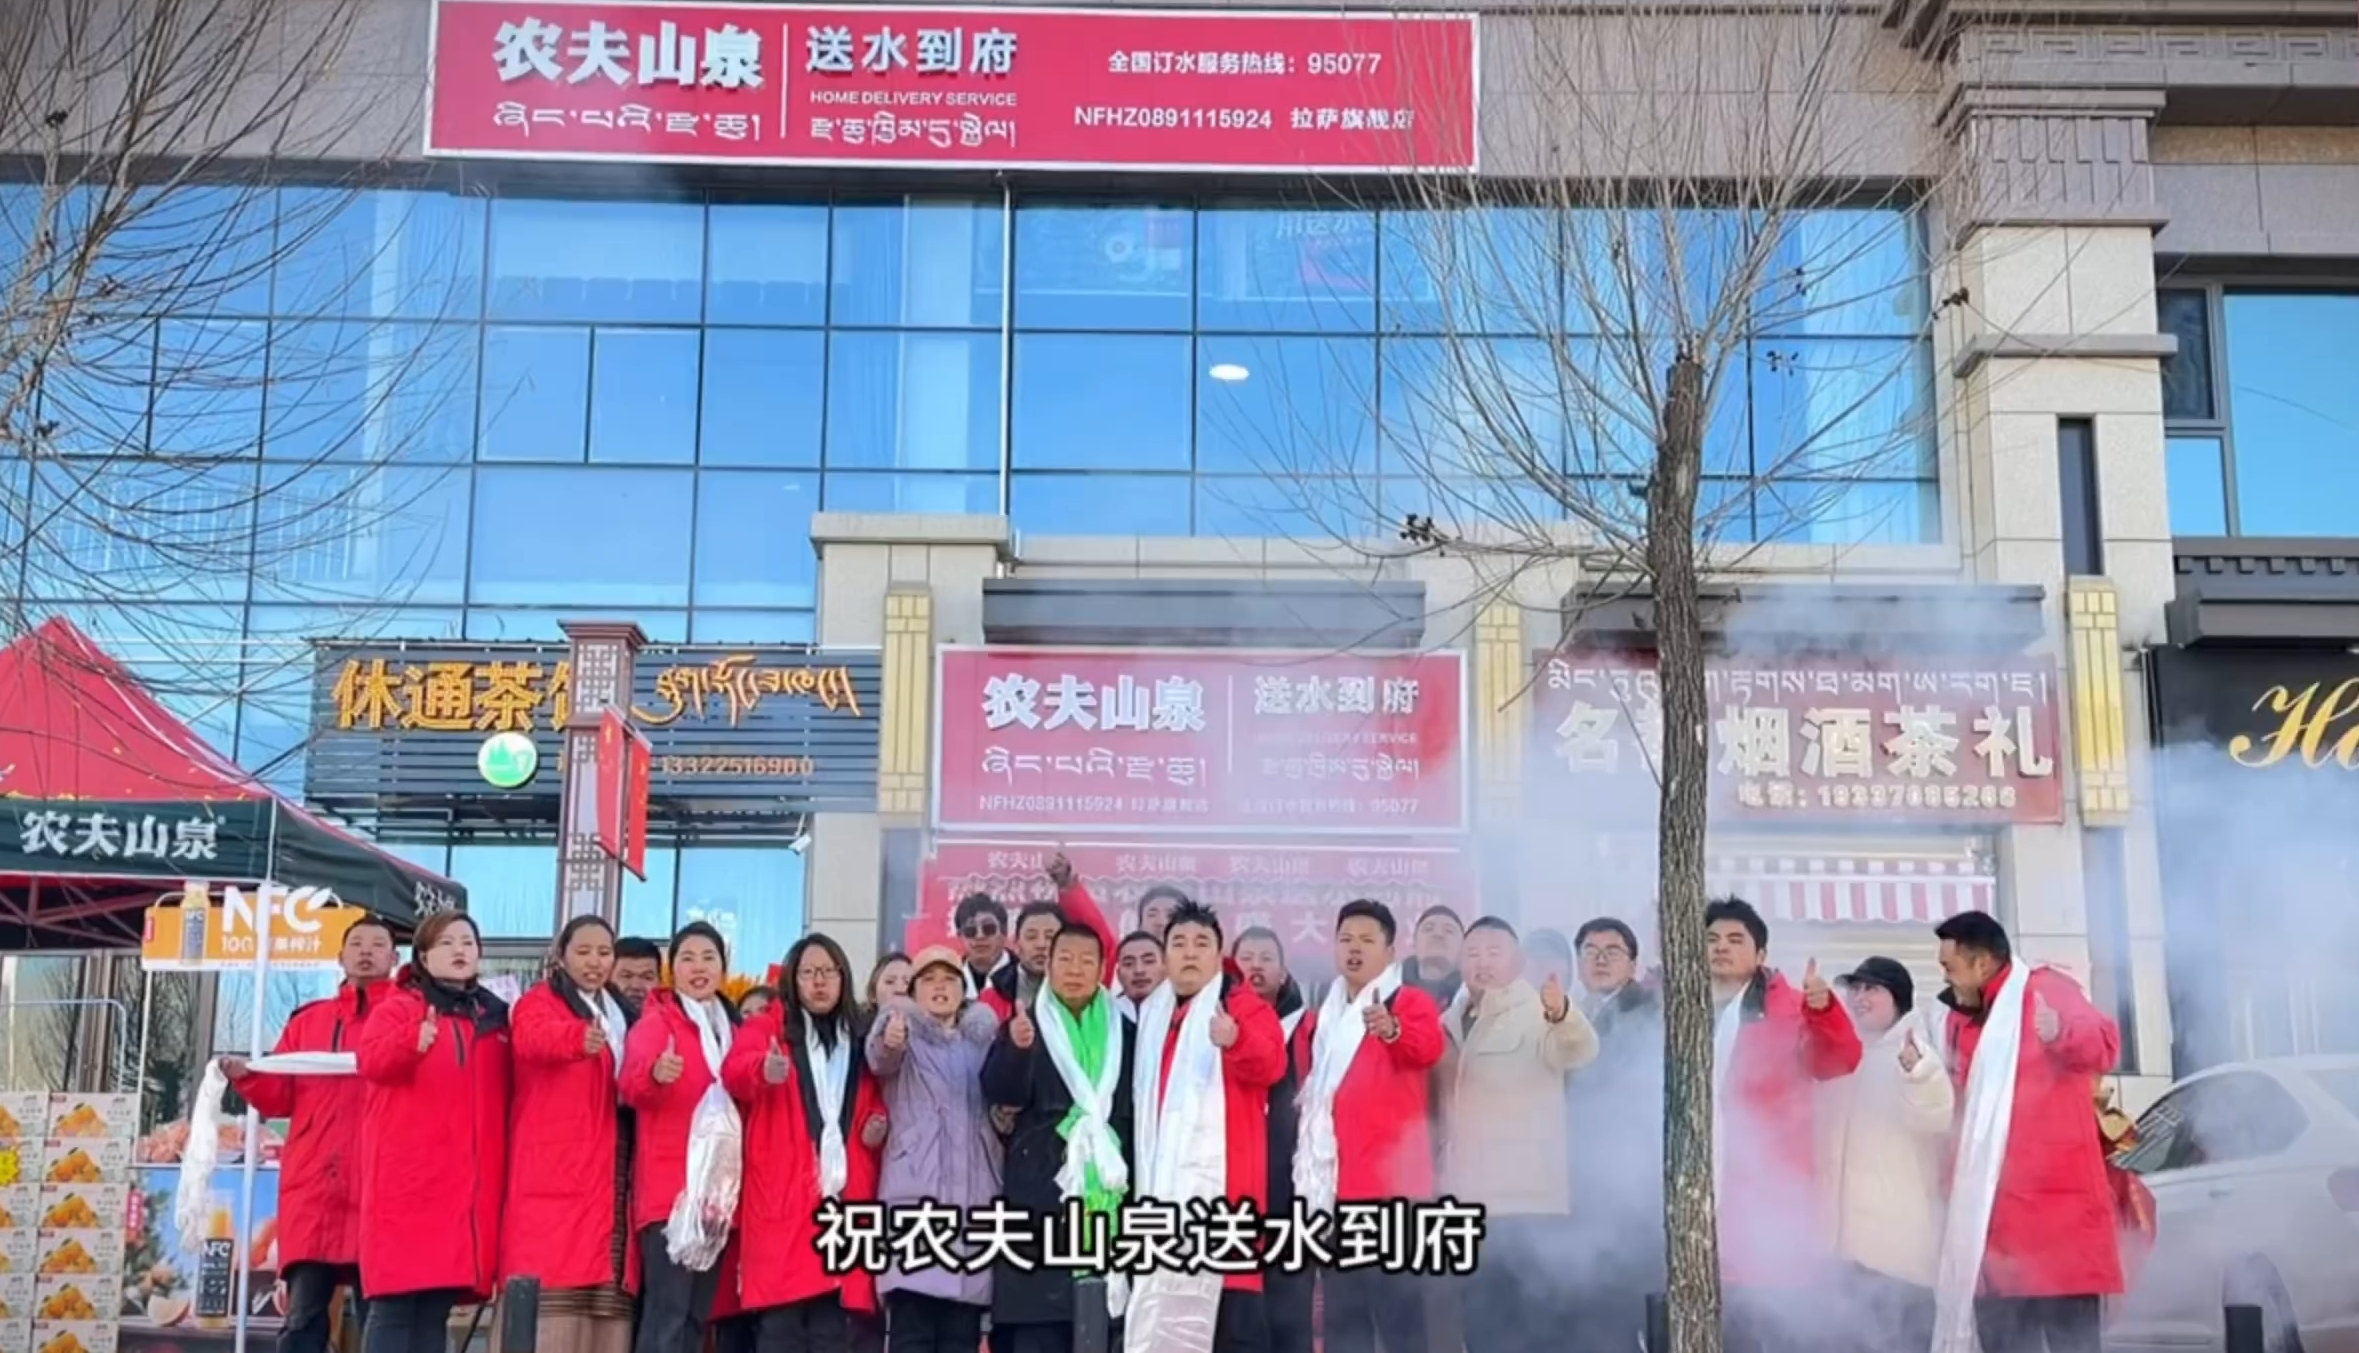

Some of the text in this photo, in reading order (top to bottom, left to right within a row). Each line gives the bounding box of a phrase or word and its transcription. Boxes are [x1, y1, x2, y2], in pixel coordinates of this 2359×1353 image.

[492, 17, 764, 88] 农夫山泉
[805, 25, 1018, 74] 送水到府
[1108, 50, 1382, 75] 全国订水服务热线：95077
[810, 90, 1018, 107] HOME DELIVERY SERVICE
[1074, 106, 1416, 131] NFHZ0891115924 拉萨旗舰店
[981, 672, 1207, 733] 农夫山泉
[1254, 675, 1419, 715] 送水到府
[20, 811, 218, 860] 农夫山泉
[223, 884, 332, 934] NFC
